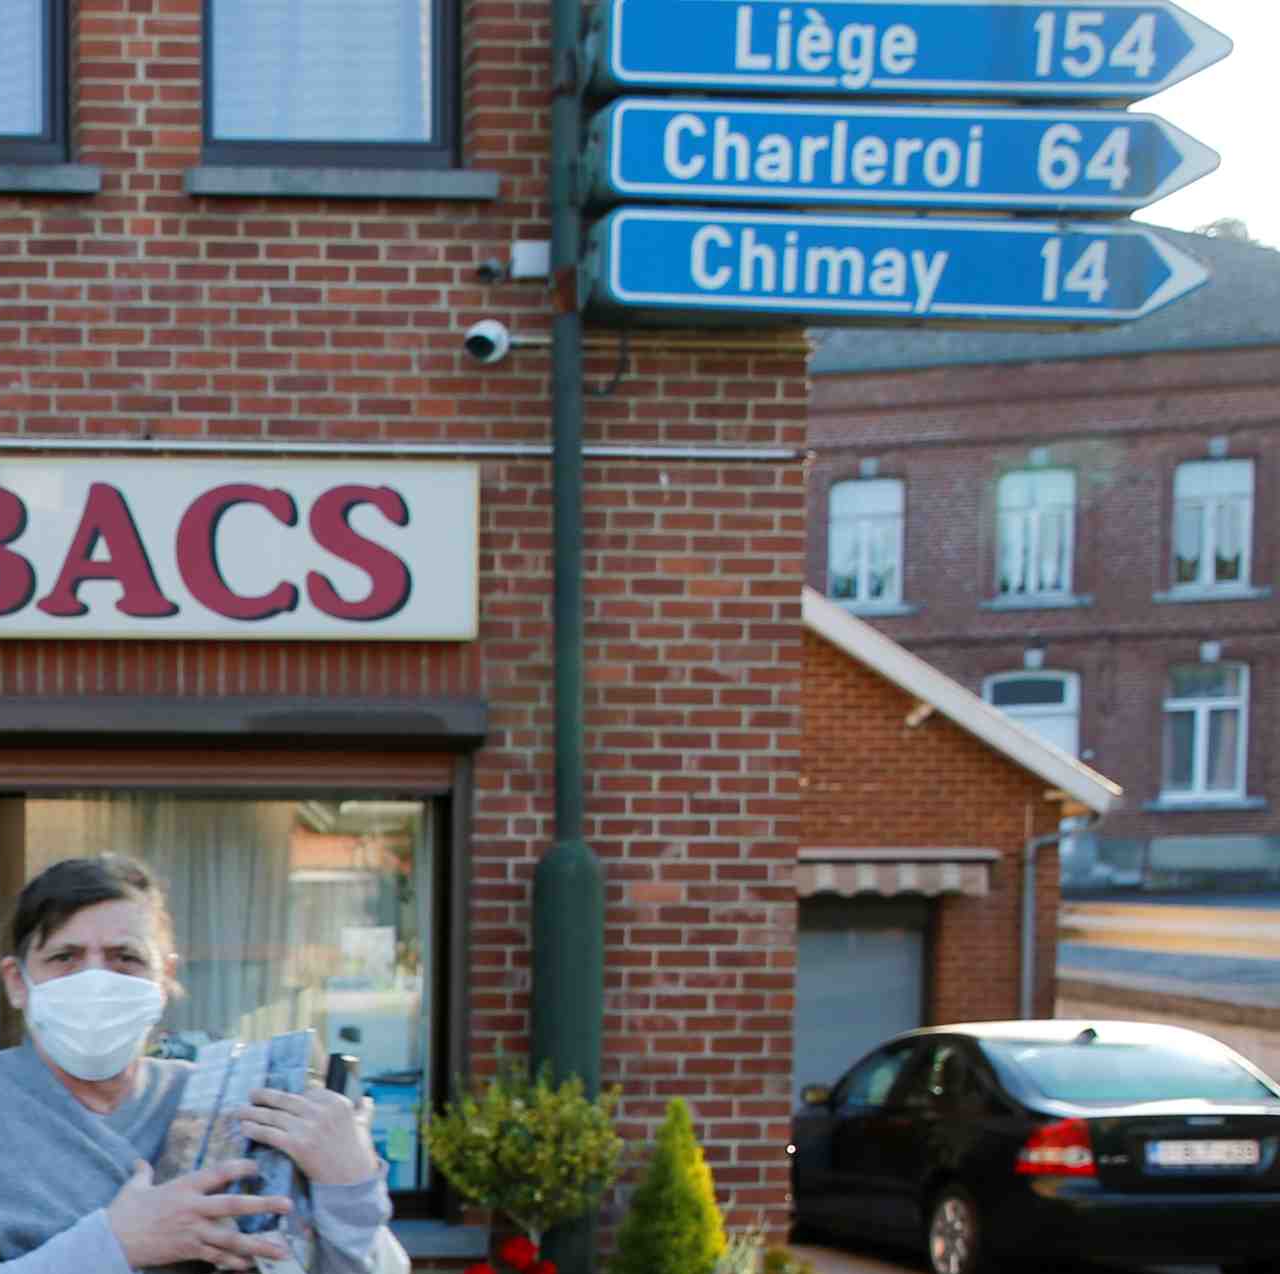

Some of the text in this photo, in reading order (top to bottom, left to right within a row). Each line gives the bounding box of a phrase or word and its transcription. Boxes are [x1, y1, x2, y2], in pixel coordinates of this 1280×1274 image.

[735, 8, 1156, 89] Liège 154
[663, 113, 1131, 191] Charleroi 64
[689, 224, 1109, 314] Chimay 14
